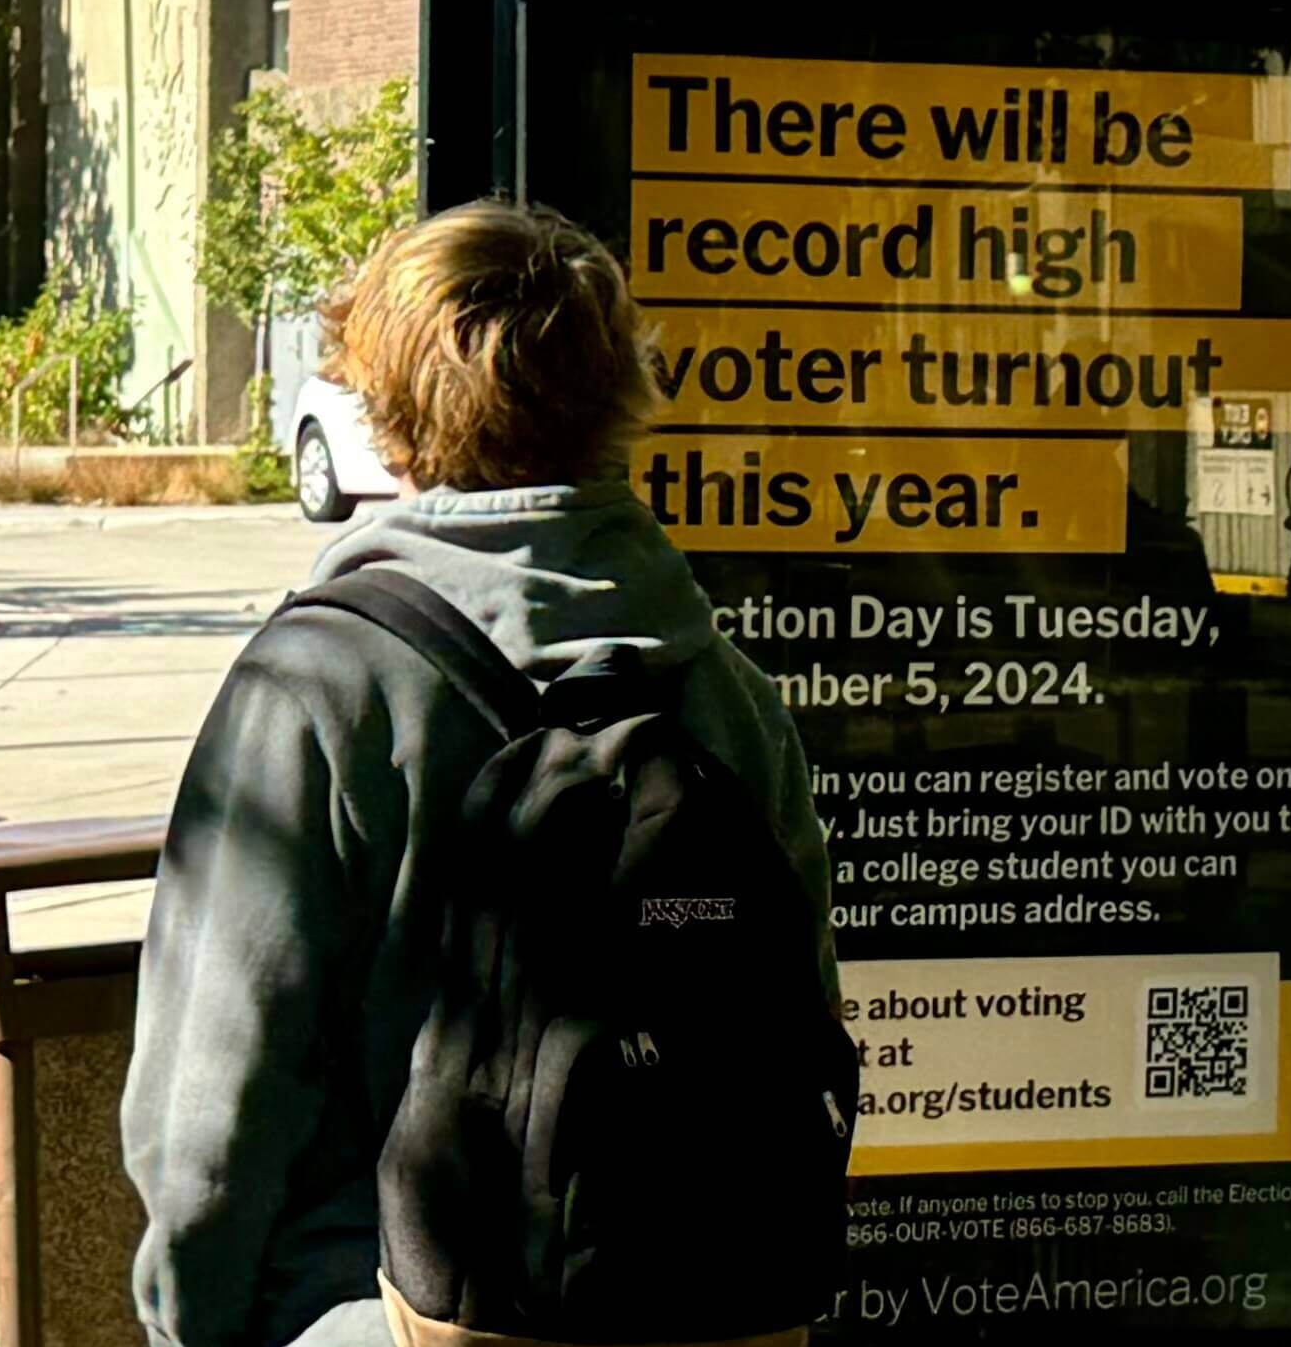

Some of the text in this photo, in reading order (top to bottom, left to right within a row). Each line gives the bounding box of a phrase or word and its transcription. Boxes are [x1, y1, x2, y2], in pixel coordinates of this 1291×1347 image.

[647, 74, 1193, 167] There will be
[647, 204, 1136, 299] record high
[649, 331, 1224, 409] voter turnout
[641, 450, 1039, 544] this year.
[710, 595, 1219, 648] ction Day is Tuesday,
[773, 661, 1104, 713] mber 5, 2024.
[848, 771, 906, 800] you
[914, 771, 972, 793] can
[980, 763, 1108, 799] register
[1114, 761, 1170, 791] and
[1177, 761, 1249, 790] vote
[851, 809, 919, 839] Just
[927, 807, 1013, 843] bring
[1020, 814, 1093, 842] your
[1100, 806, 1132, 835] ID
[1140, 805, 1206, 834] with
[1214, 811, 1270, 839] you
[836, 850, 1237, 887] a college student you can
[828, 893, 1160, 931] our campus address.
[867, 989, 968, 1021] about
[976, 986, 1086, 1023] voting
[877, 1037, 914, 1068] at
[859, 1079, 1112, 1120] a.org/students
[899, 1195, 913, 1214] If
[917, 1196, 988, 1217] anyone
[993, 1191, 1036, 1212] tries
[1040, 1191, 1062, 1210] to
[1064, 1191, 1109, 1211] stop
[1155, 1185, 1188, 1206] call
[1193, 1187, 1224, 1205] the
[861, 1279, 909, 1326] by
[921, 1268, 1268, 1316] VoteAmerica.org
